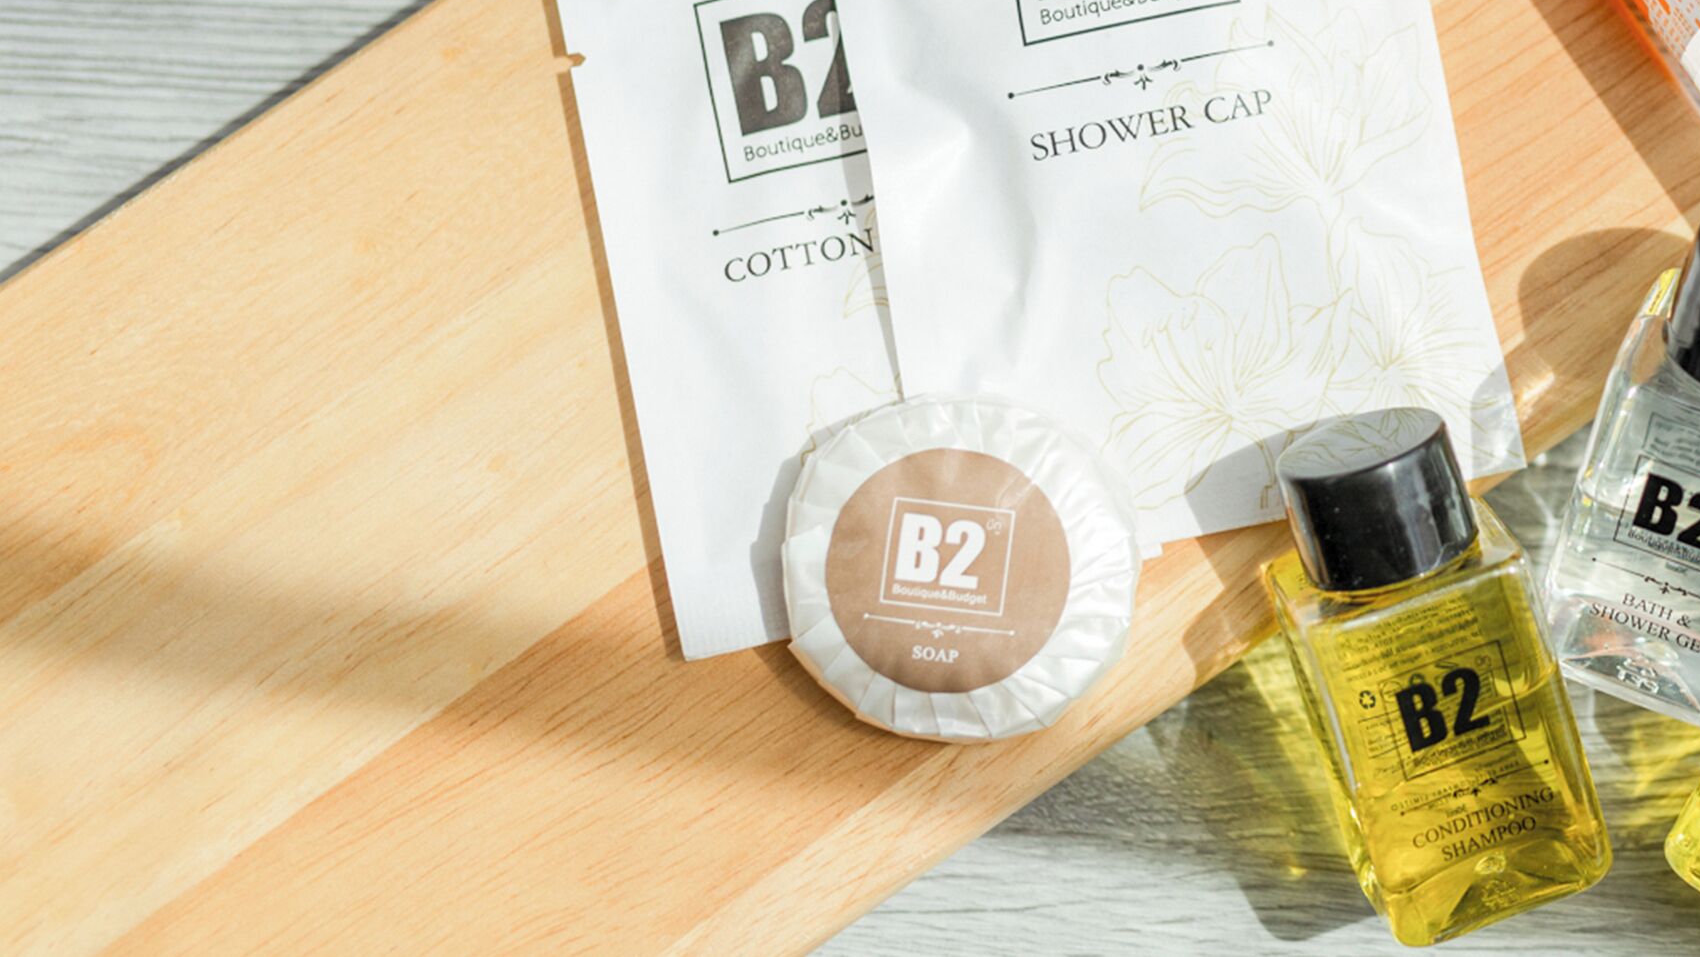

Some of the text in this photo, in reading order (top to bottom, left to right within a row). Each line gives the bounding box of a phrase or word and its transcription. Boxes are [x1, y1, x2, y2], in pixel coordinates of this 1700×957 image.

[743, 123, 863, 162] Boutique&Bu
[1030, 89, 1272, 162] SHOWER CAP
[724, 227, 874, 282] COTTON
[894, 513, 986, 590] B2
[892, 583, 988, 605] Boutique&Budget
[1622, 592, 1692, 629] BATH &
[1589, 603, 1671, 642] SHOWER
[912, 645, 959, 664] SOAP
[1395, 667, 1490, 753] B2
[1412, 786, 1555, 849] CONDITIONING
[1441, 816, 1537, 862] SHAMPOO
